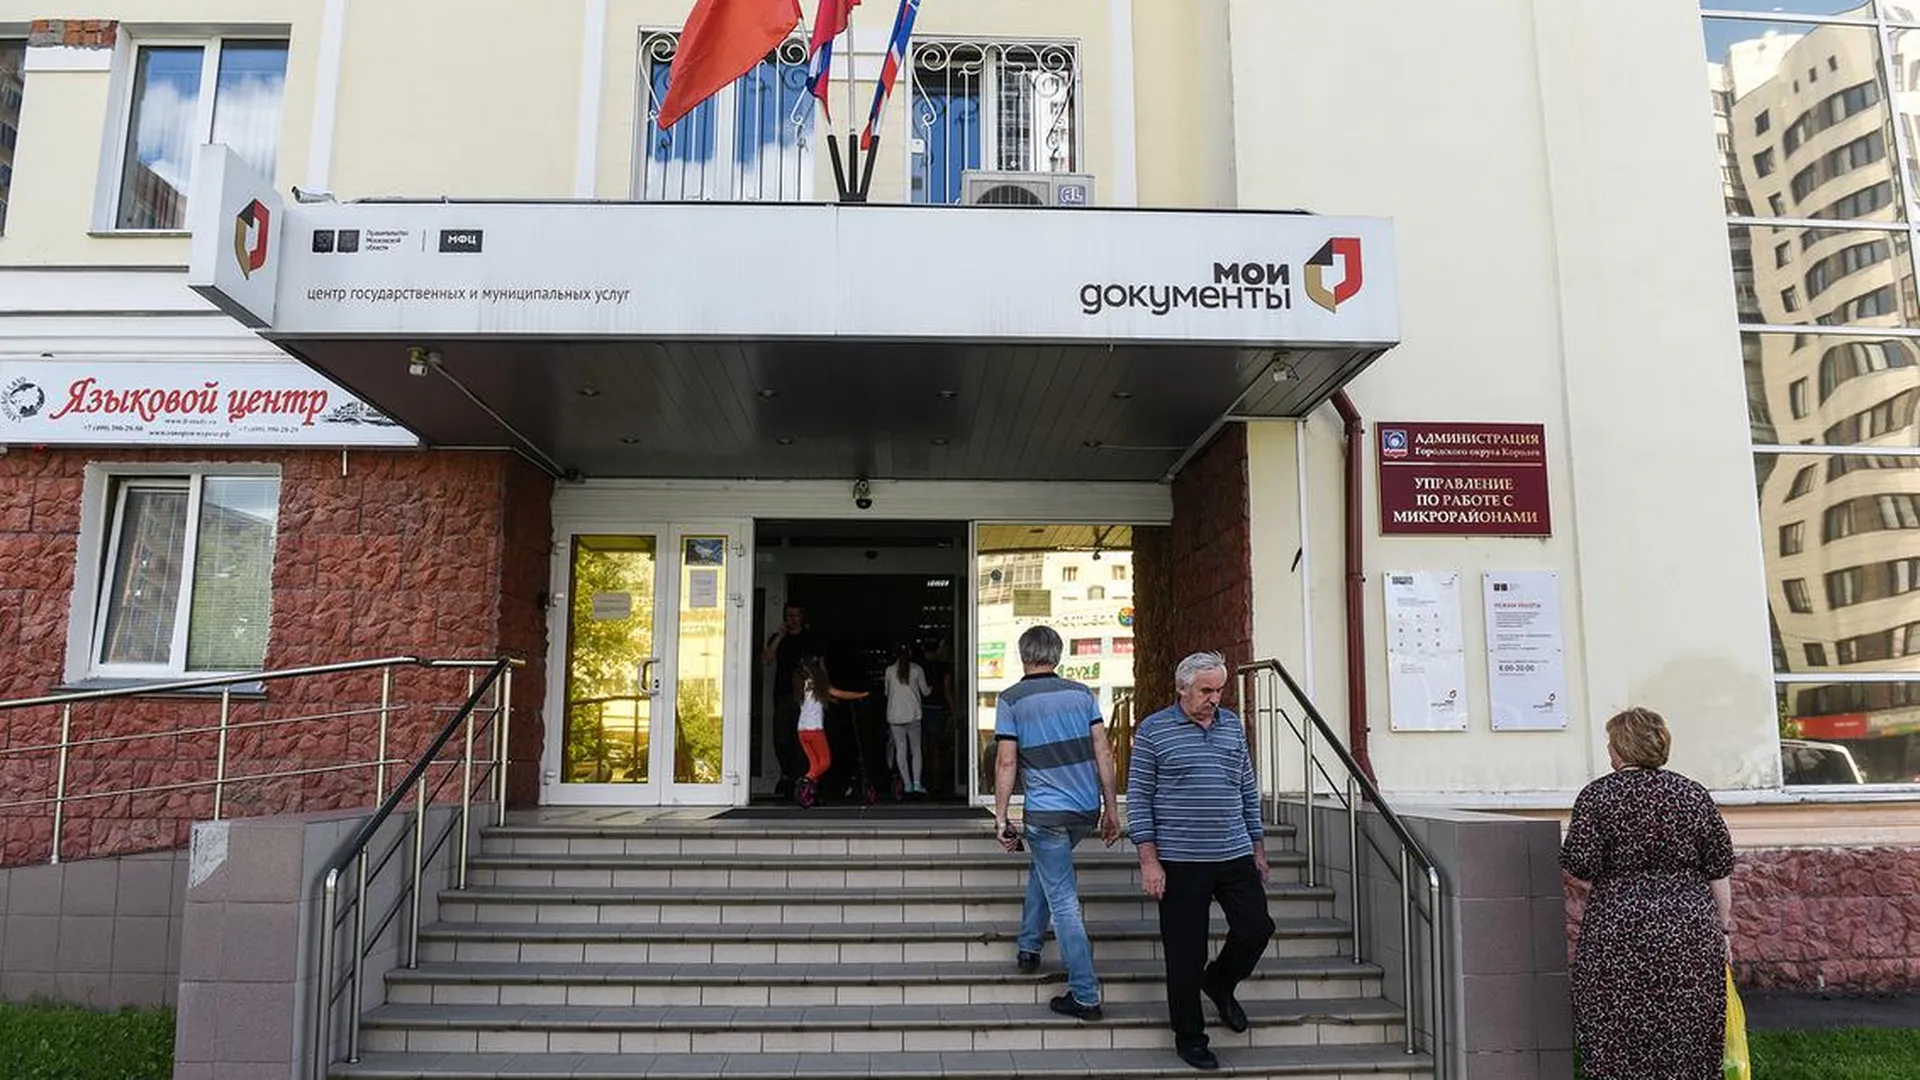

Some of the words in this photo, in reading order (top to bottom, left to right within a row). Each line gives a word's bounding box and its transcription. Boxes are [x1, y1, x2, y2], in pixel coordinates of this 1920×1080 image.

[447, 234, 477, 245] МФЦ
[307, 289, 347, 303] центр
[350, 288, 466, 303] государственных
[469, 289, 478, 300] и
[482, 289, 591, 303] муниципальных
[594, 289, 631, 304] услуг
[1080, 284, 1291, 316] документы
[49, 377, 218, 421] Языковой
[229, 389, 328, 425] центр
[1415, 432, 1539, 445] АДМИНИСТРАЦИЯ
[1415, 446, 1468, 458] Городского
[1469, 448, 1500, 458] округа
[1414, 477, 1514, 490] УПРАВЛЕНИЕ
[1416, 494, 1440, 507] ПО
[1442, 494, 1500, 507] РАБОТЕ
[1502, 494, 1514, 507] С
[1393, 508, 1538, 523] МИКРОРАЙОНАМИ
